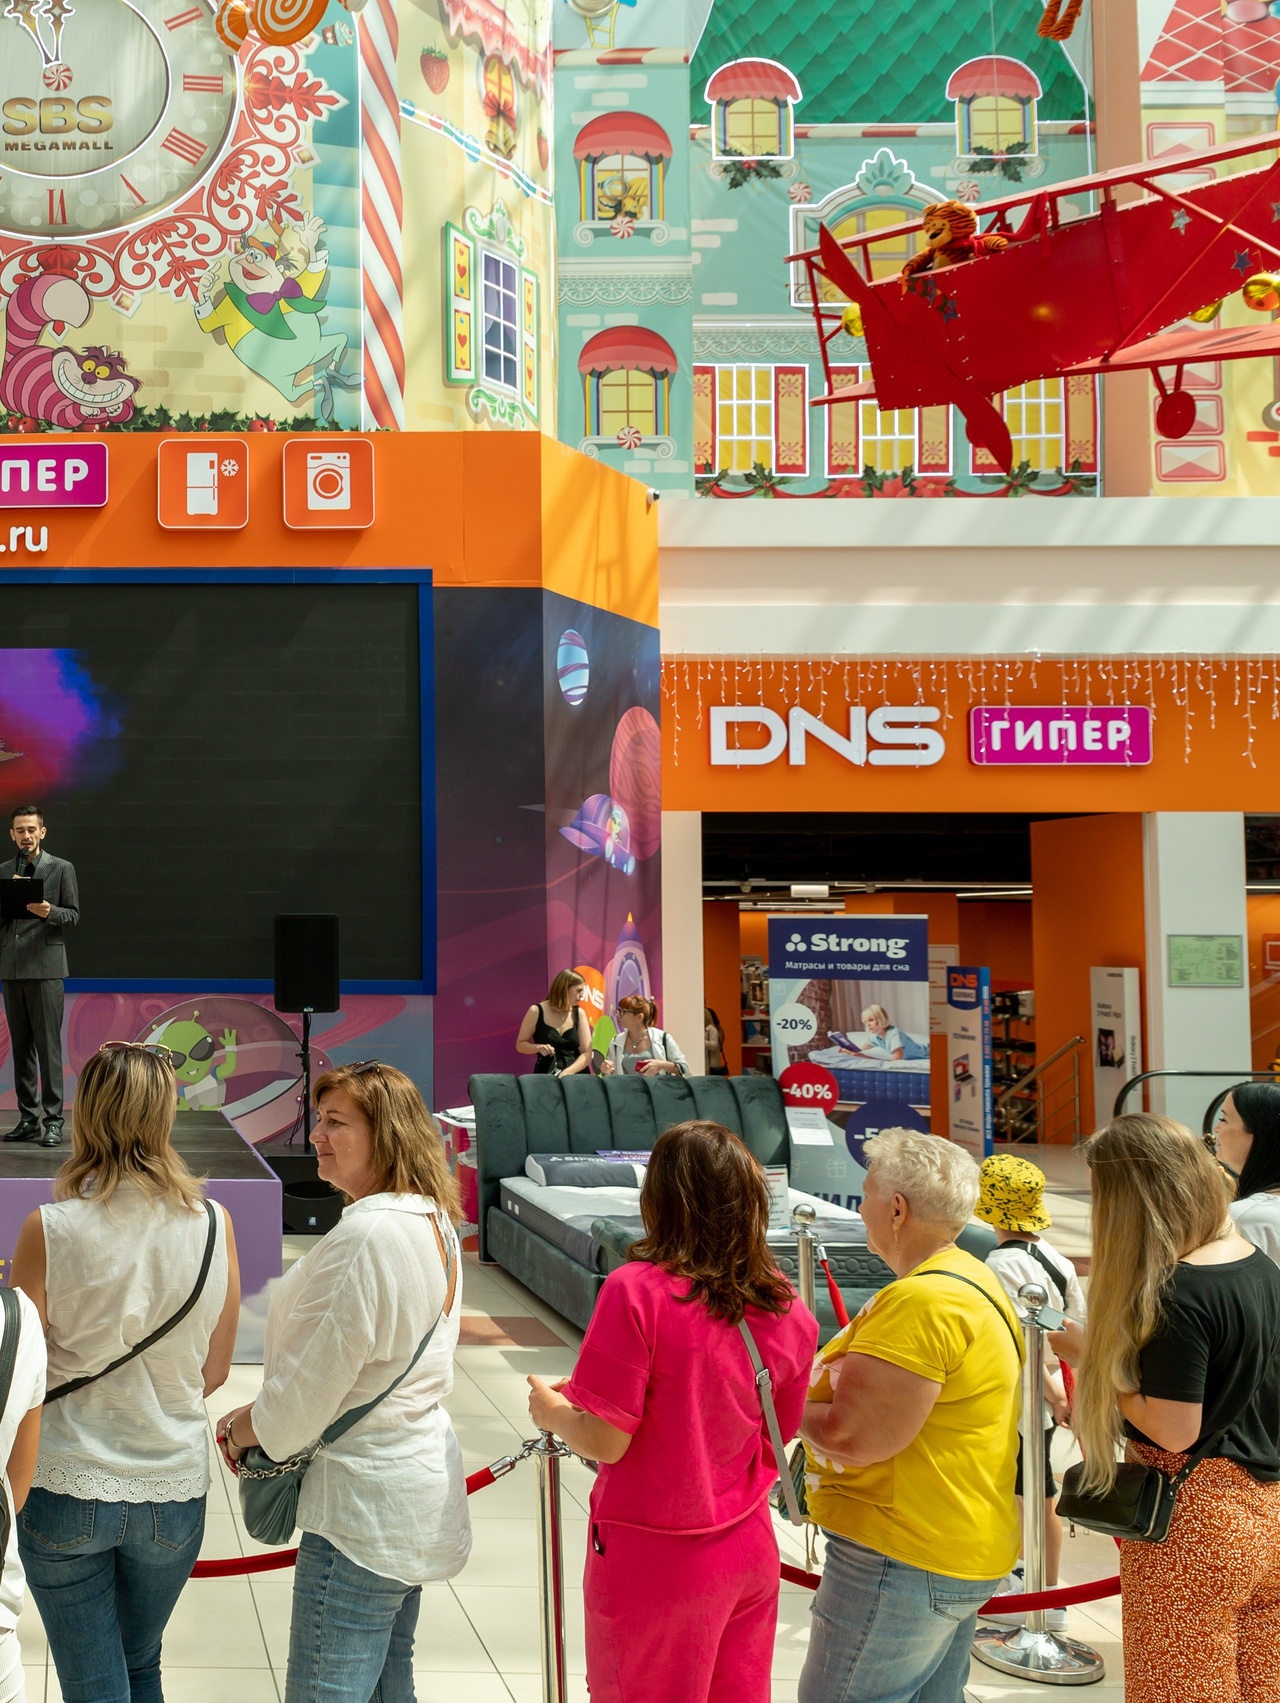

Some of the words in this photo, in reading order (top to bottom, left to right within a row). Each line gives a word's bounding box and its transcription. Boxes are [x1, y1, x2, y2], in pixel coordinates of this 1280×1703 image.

[2, 95, 114, 136] SBS
[4, 139, 114, 152] MEGAMALL
[709, 706, 946, 766] DNS
[990, 720, 1131, 752] ГИПЕР
[811, 933, 909, 959] Strong
[785, 961, 826, 971] Матрасы
[828, 962, 834, 970] и
[836, 963, 870, 972] товары
[872, 963, 890, 972] для
[950, 973, 978, 987] DNS
[776, 1018, 812, 1031] -20%
[782, 1083, 833, 1100] -40%
